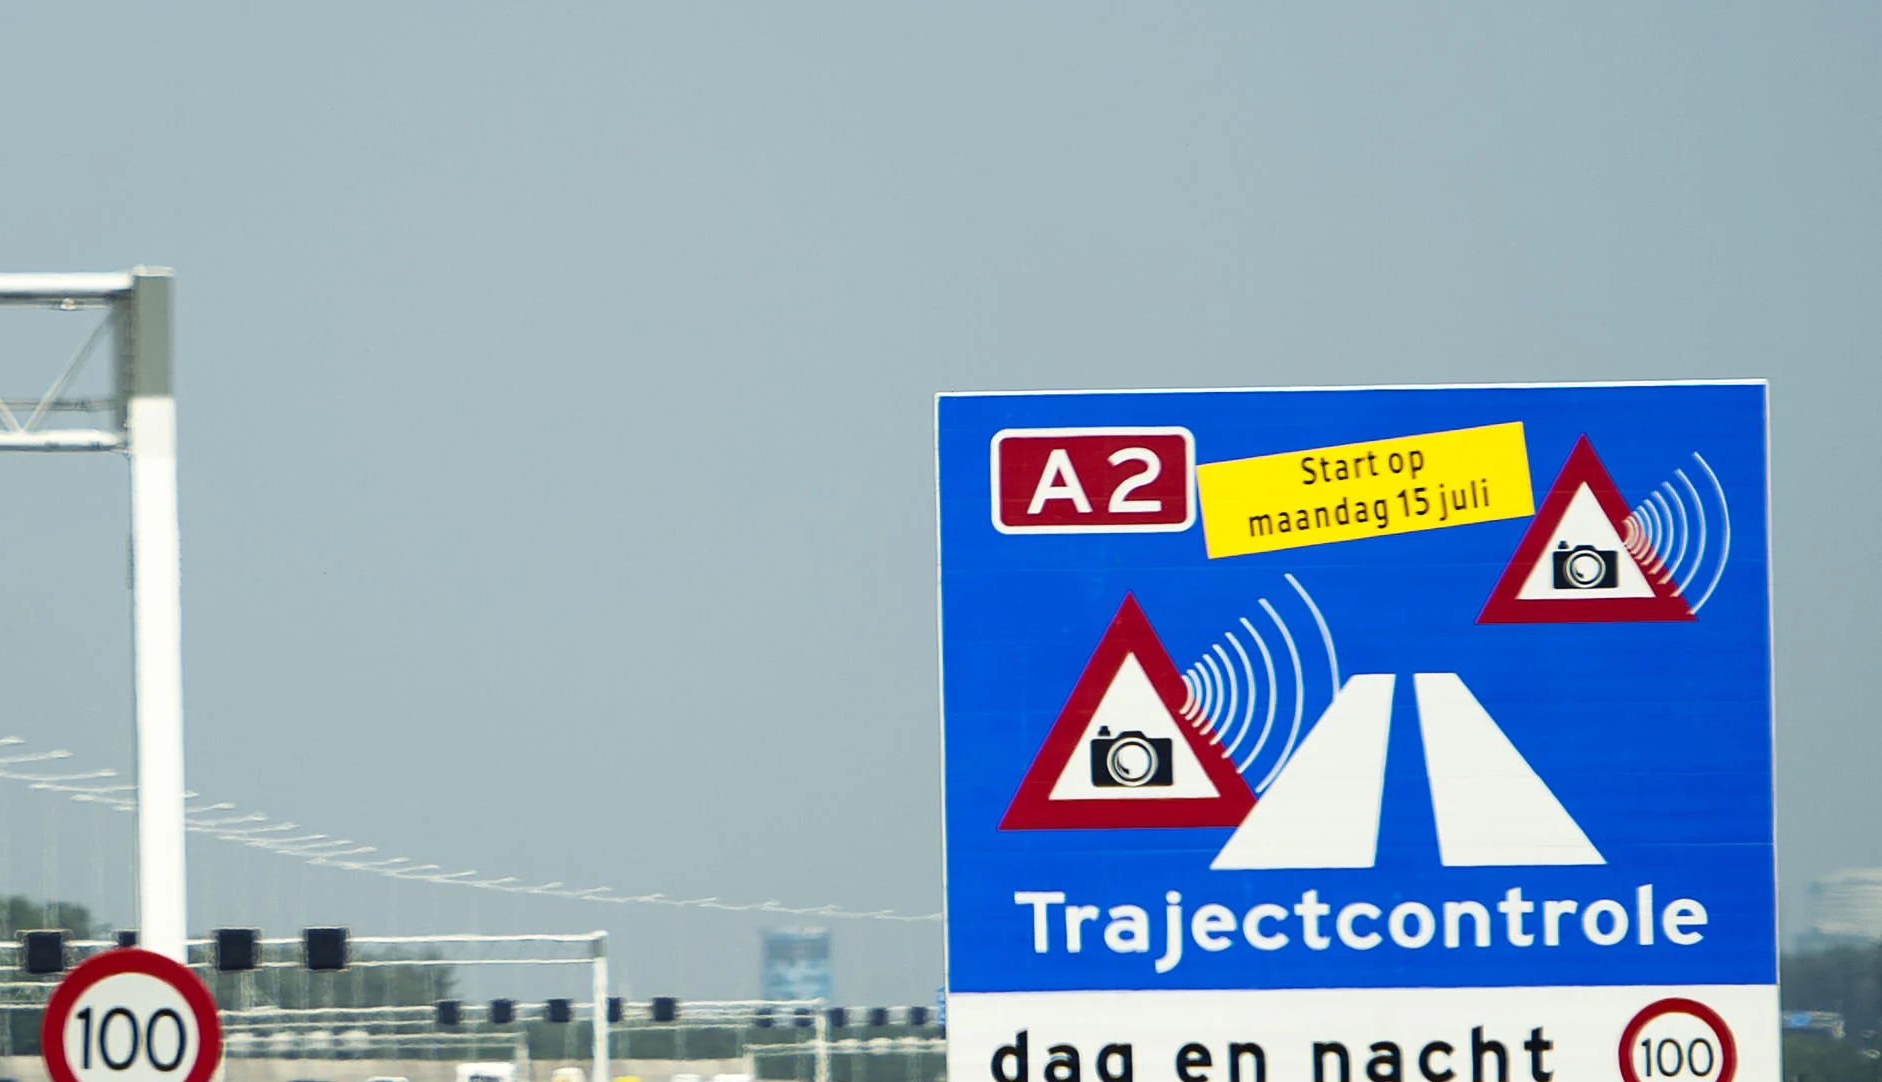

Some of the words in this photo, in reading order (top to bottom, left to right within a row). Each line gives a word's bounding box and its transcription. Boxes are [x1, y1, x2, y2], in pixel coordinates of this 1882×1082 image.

[1026, 446, 1163, 515] A2
[1301, 451, 1378, 486] Start
[1388, 450, 1425, 480] op
[1249, 497, 1390, 538] maandag
[1397, 487, 1430, 518] 15
[1438, 478, 1490, 522] juli
[1014, 884, 1708, 974] Trajectcontrole
[75, 1006, 188, 1072] 100
[1640, 1036, 1715, 1078] 100
